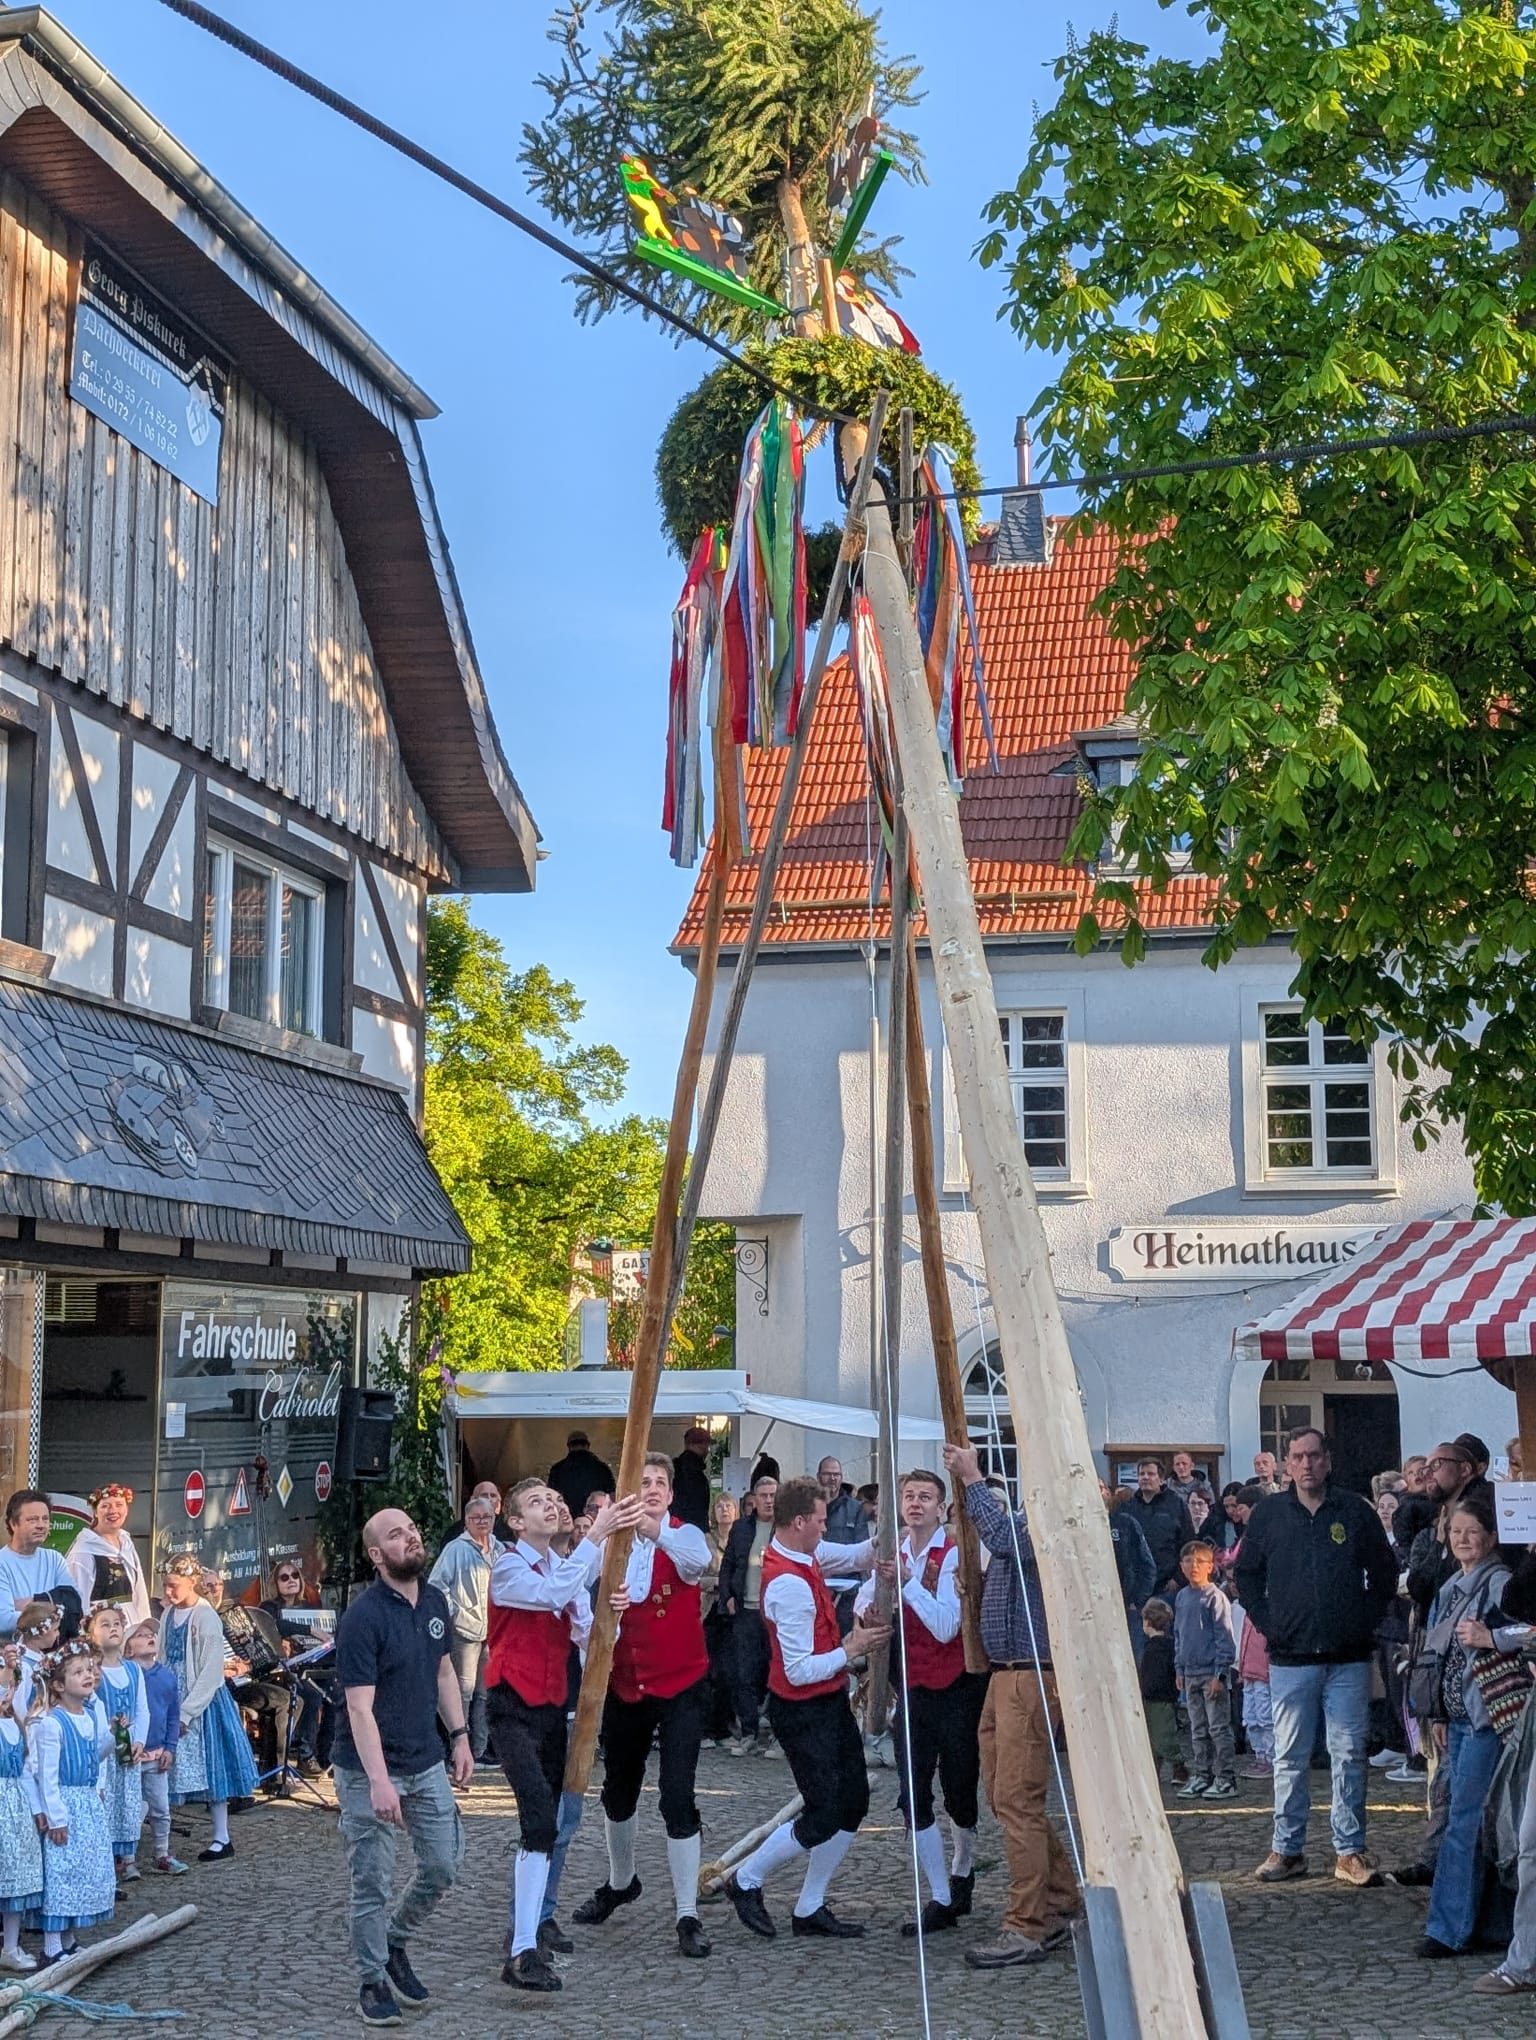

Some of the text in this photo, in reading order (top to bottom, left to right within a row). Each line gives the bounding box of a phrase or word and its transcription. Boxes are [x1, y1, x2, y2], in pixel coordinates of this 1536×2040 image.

[88, 259, 187, 360] Georg Piskurek
[84, 313, 161, 389] Dachdeckerei
[78, 371, 106, 405] Mobil:
[107, 393, 129, 422] 0172
[105, 369, 111, 385] 0
[112, 377, 124, 394] 29
[1133, 1230, 1358, 1270] Heimathaus
[178, 1311, 297, 1360] Fahrschule
[258, 1360, 343, 1422] Cabriolet
[316, 1473, 330, 1489] STOP
[49, 1520, 74, 1530] chule
[222, 1549, 257, 1563] Ausbildung
